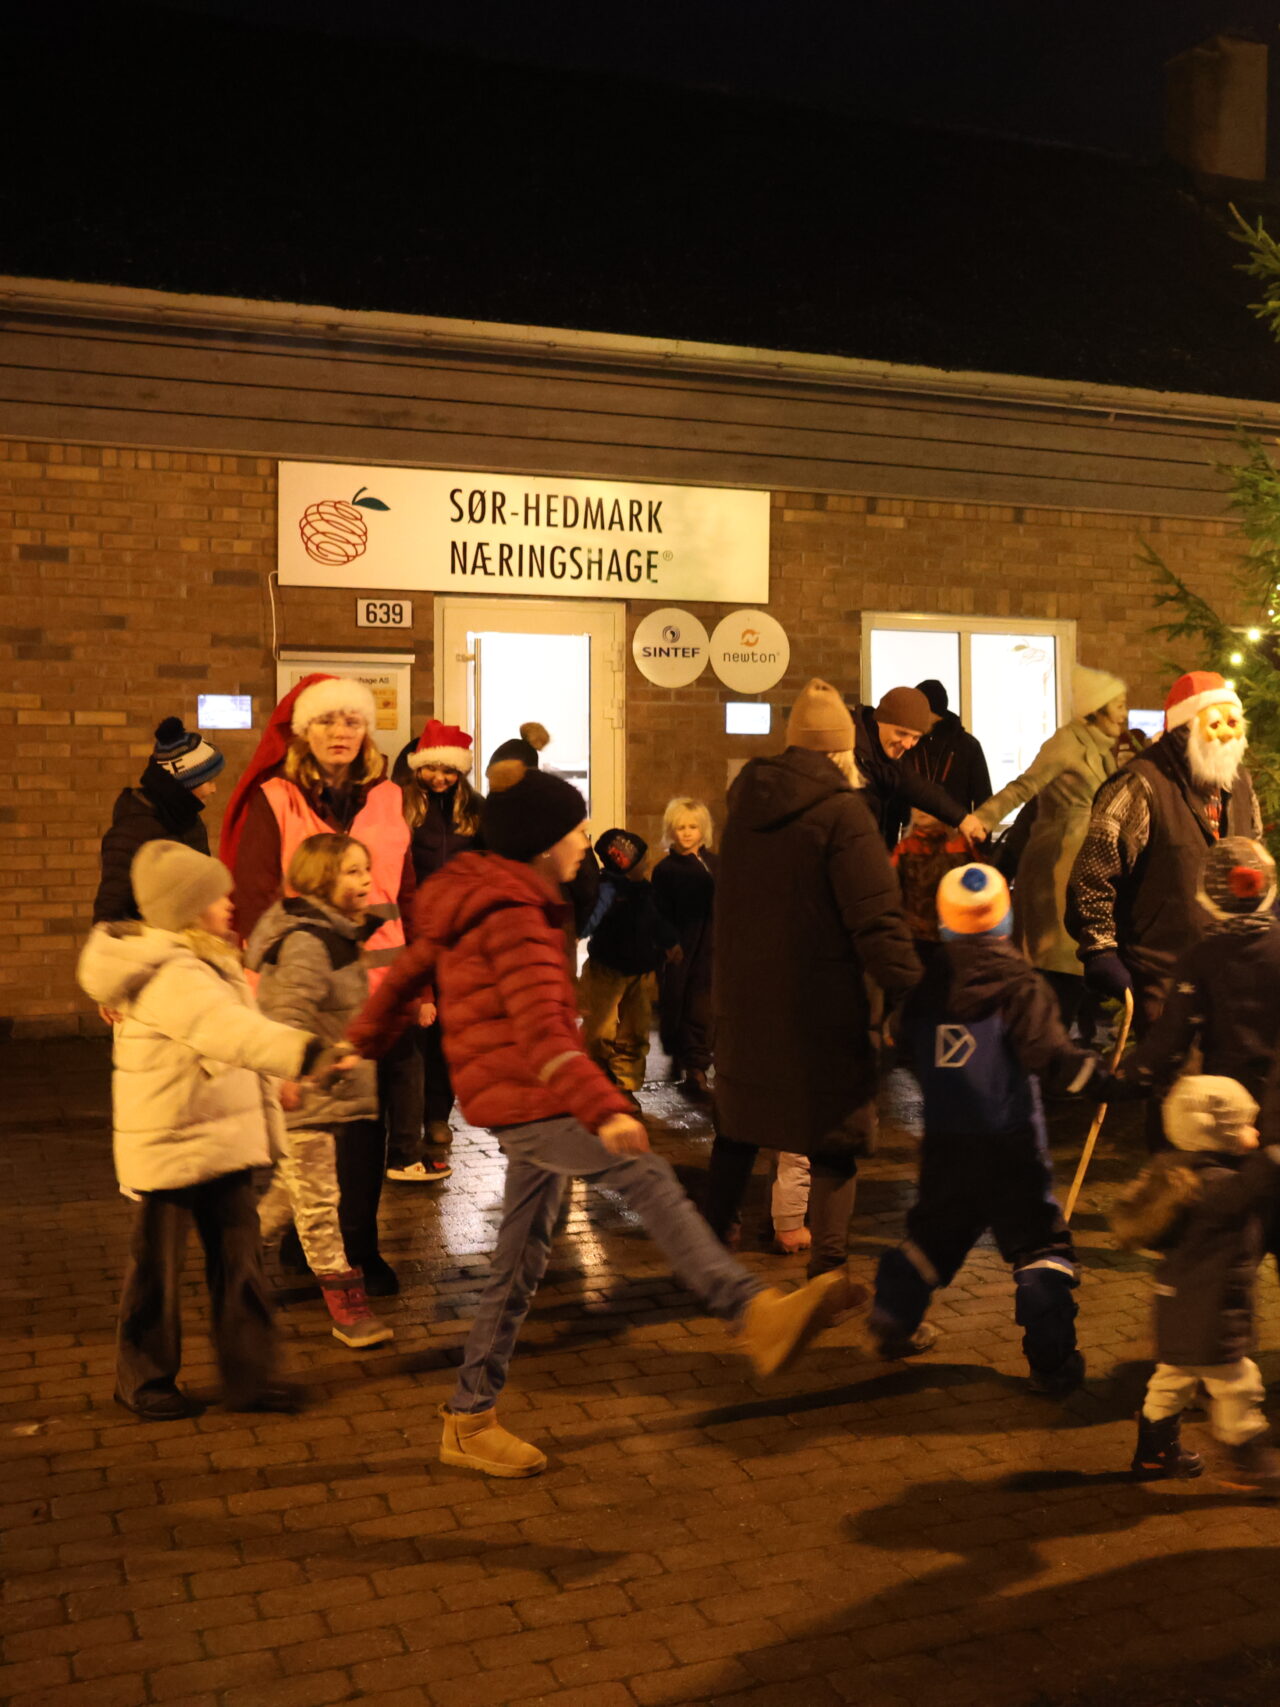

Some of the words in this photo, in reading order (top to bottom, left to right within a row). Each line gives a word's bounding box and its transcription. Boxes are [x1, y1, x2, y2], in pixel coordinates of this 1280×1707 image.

[449, 488, 663, 534] SØR-HEDMARK
[365, 602, 403, 624] 639
[642, 646, 700, 658] SINTEF
